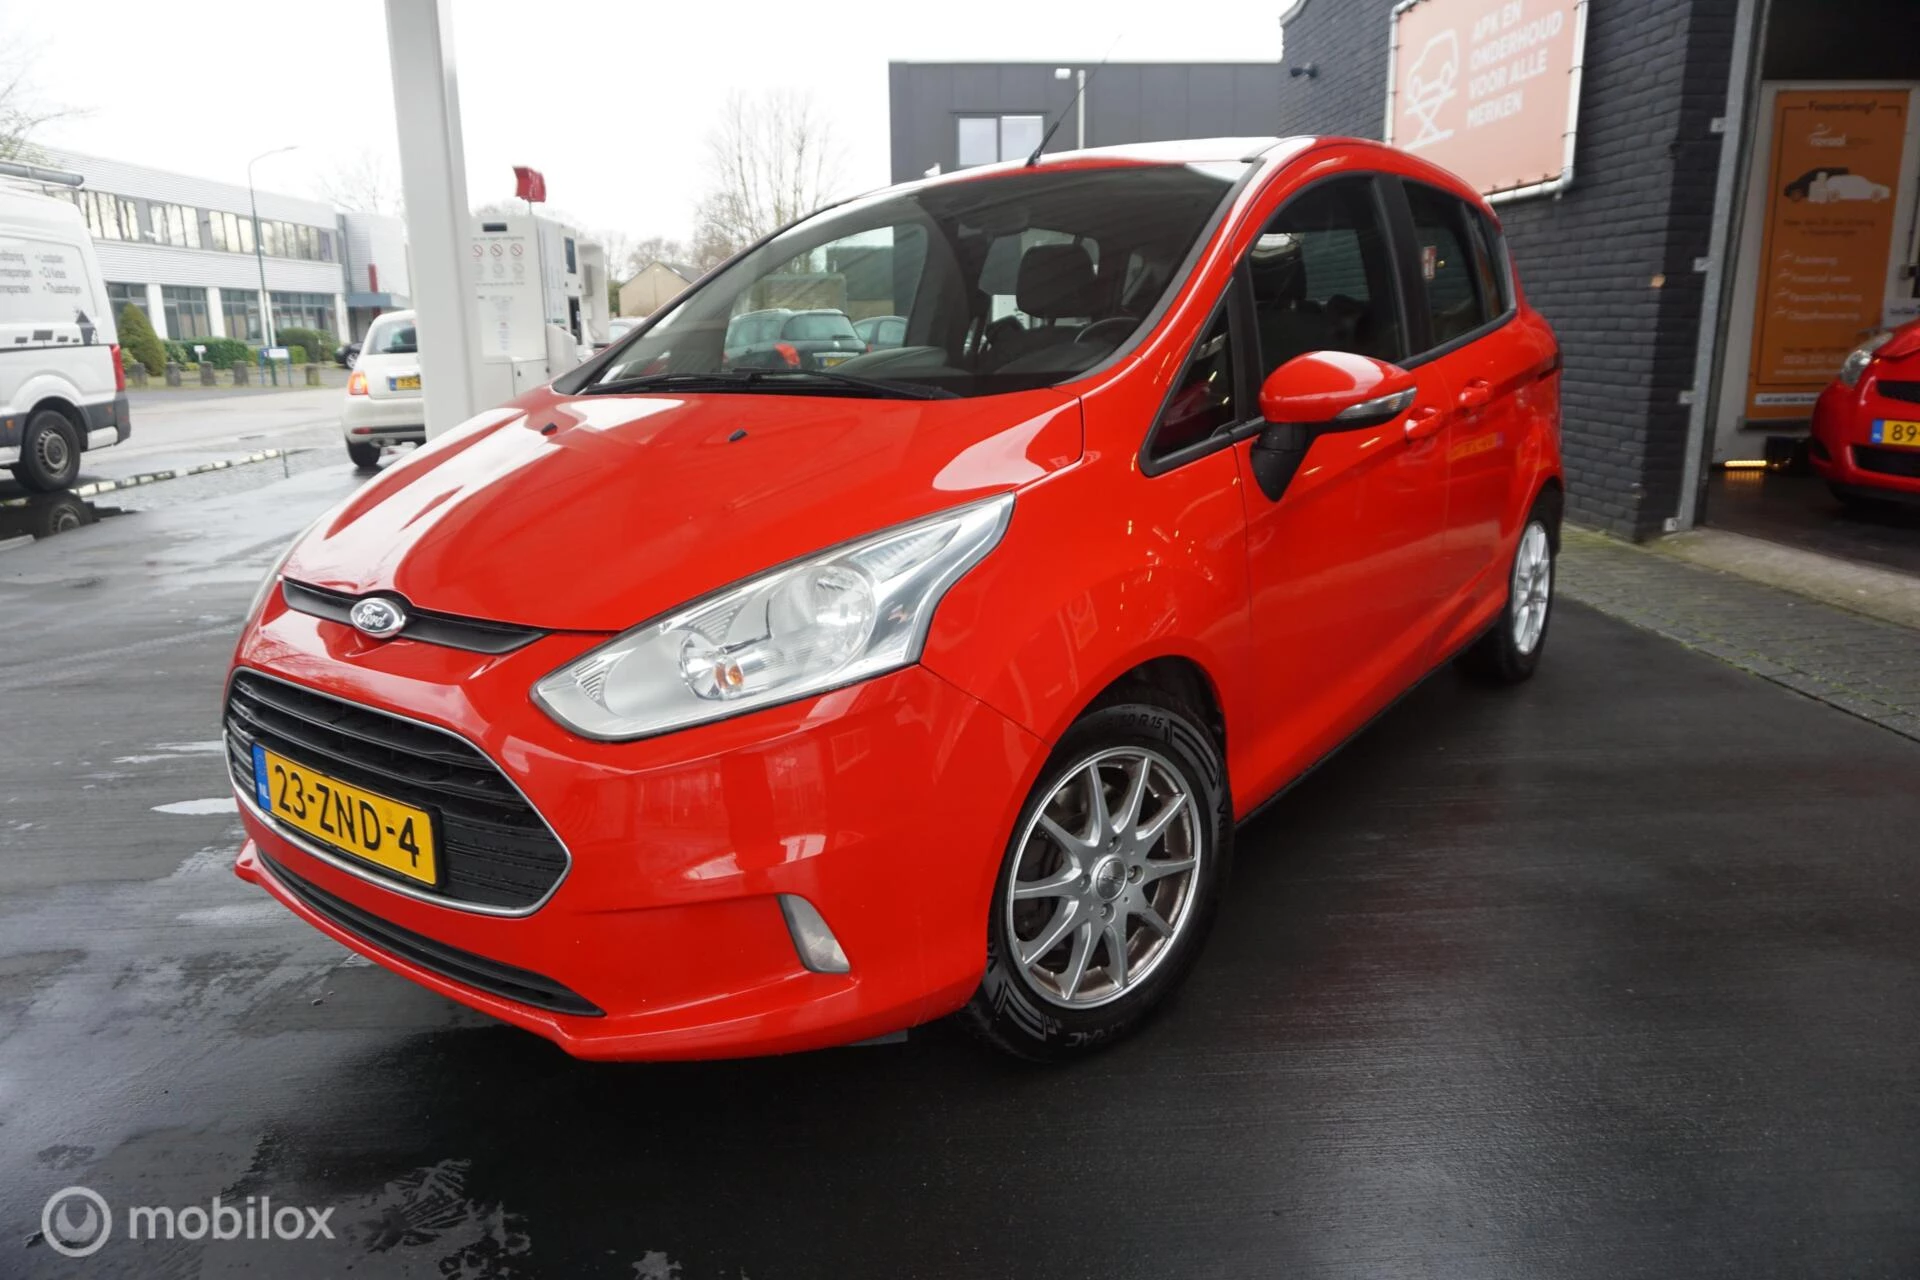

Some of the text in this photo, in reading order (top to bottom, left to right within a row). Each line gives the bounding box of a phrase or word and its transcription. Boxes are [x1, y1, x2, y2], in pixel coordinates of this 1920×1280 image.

[1471, 10, 1563, 70] ONDERHOUD
[1472, 1, 1523, 42] APK EN
[1469, 48, 1548, 101] VOOR ALLE
[1466, 91, 1523, 129] MERKEN
[356, 602, 388, 628] Ford
[274, 764, 420, 868] 23-ZND-4
